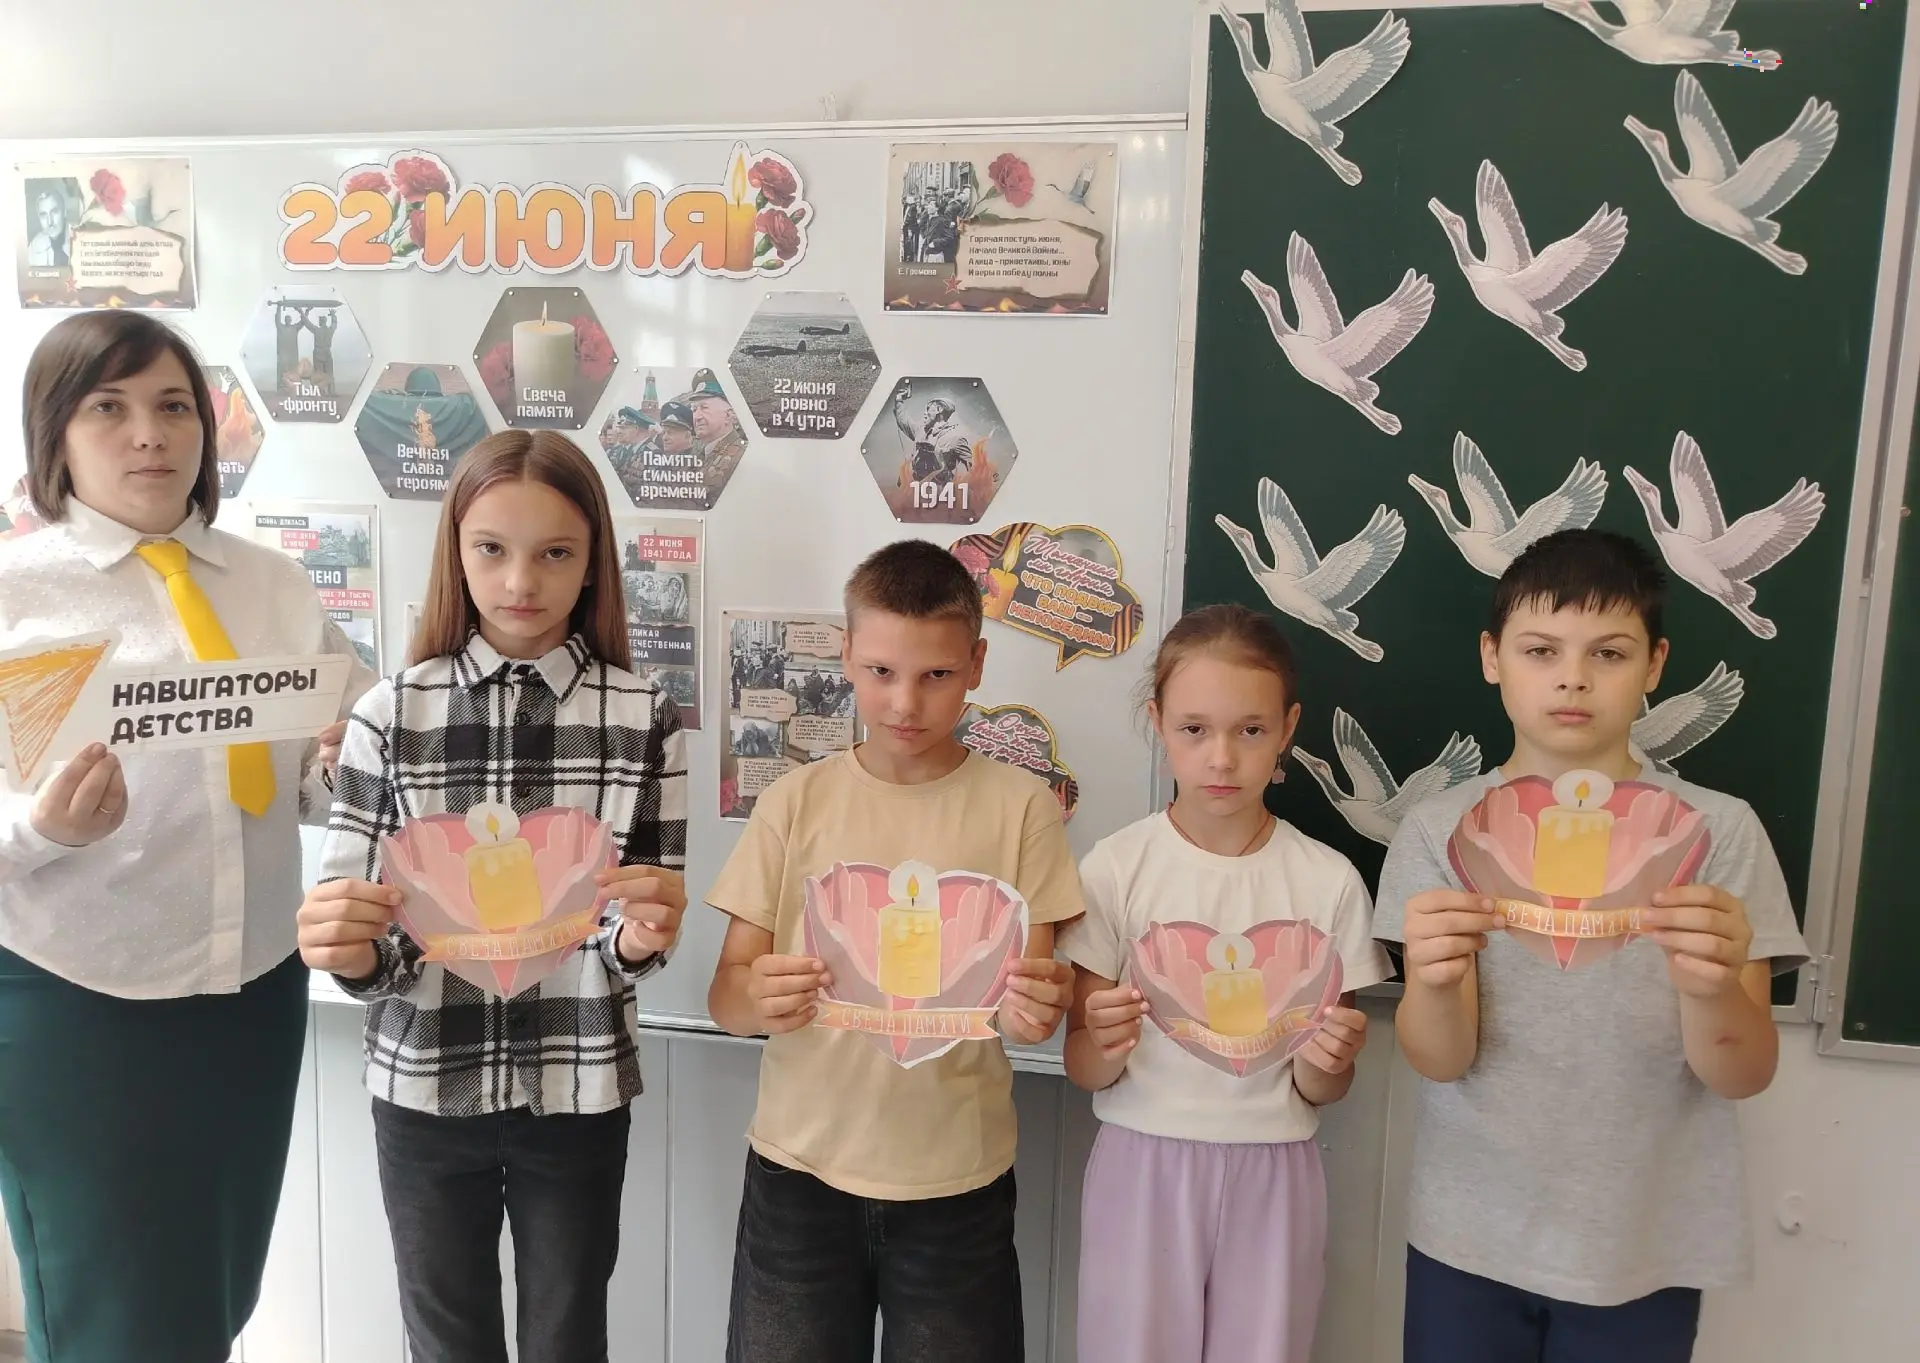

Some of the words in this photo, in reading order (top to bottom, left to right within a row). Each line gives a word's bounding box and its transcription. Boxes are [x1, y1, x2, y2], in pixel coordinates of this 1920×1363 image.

[283, 189, 393, 265] 22
[423, 189, 727, 269] ИЮНЯ
[969, 235, 1003, 244] Горячая
[1003, 236, 1037, 244] поступь
[998, 246, 1031, 254] Великой
[975, 259, 993, 267] лица
[999, 259, 1051, 267] приветливы,
[1002, 269, 1032, 278] победу
[293, 382, 321, 396] Тыл
[774, 378, 791, 393] 22
[793, 382, 836, 395] июня
[523, 387, 566, 402] Свеча
[279, 397, 337, 415] -фронту
[517, 405, 574, 419] памяти
[780, 397, 828, 412] ровно
[772, 414, 782, 426] в
[785, 414, 795, 426] 4
[799, 415, 836, 430] утра
[397, 444, 449, 461] Вечная
[643, 451, 703, 467] Память
[402, 461, 444, 475] слава
[643, 469, 704, 483] сильнее
[397, 477, 449, 492] героям
[641, 485, 707, 500] времени
[910, 481, 969, 509] 1941
[644, 538, 654, 547] 22
[659, 538, 683, 548] ИЮНЯ
[643, 549, 663, 558] 1941
[667, 551, 692, 560] ГОДА
[1021, 571, 1053, 592] ЧТО
[1053, 584, 1121, 615] ПОДВИГ
[1037, 594, 1075, 618] ВАШ
[628, 629, 660, 637] ЕЛИКАЯ
[628, 639, 692, 650] ТЕЧЕСТВЕННАЯ
[632, 649, 649, 658] ЙНА
[112, 669, 317, 707] НАВИГАТОРЫ
[110, 705, 253, 745] ДЕТСТВА
[1506, 904, 1556, 933] ВЕЧА
[1564, 909, 1641, 936] ПАМЯТИ
[446, 935, 502, 957] СВЕЧА
[840, 1008, 896, 1033] СВЕЧА
[903, 1013, 972, 1035] ПАМЯТИ
[1188, 1022, 1235, 1057] СВЕЧА
